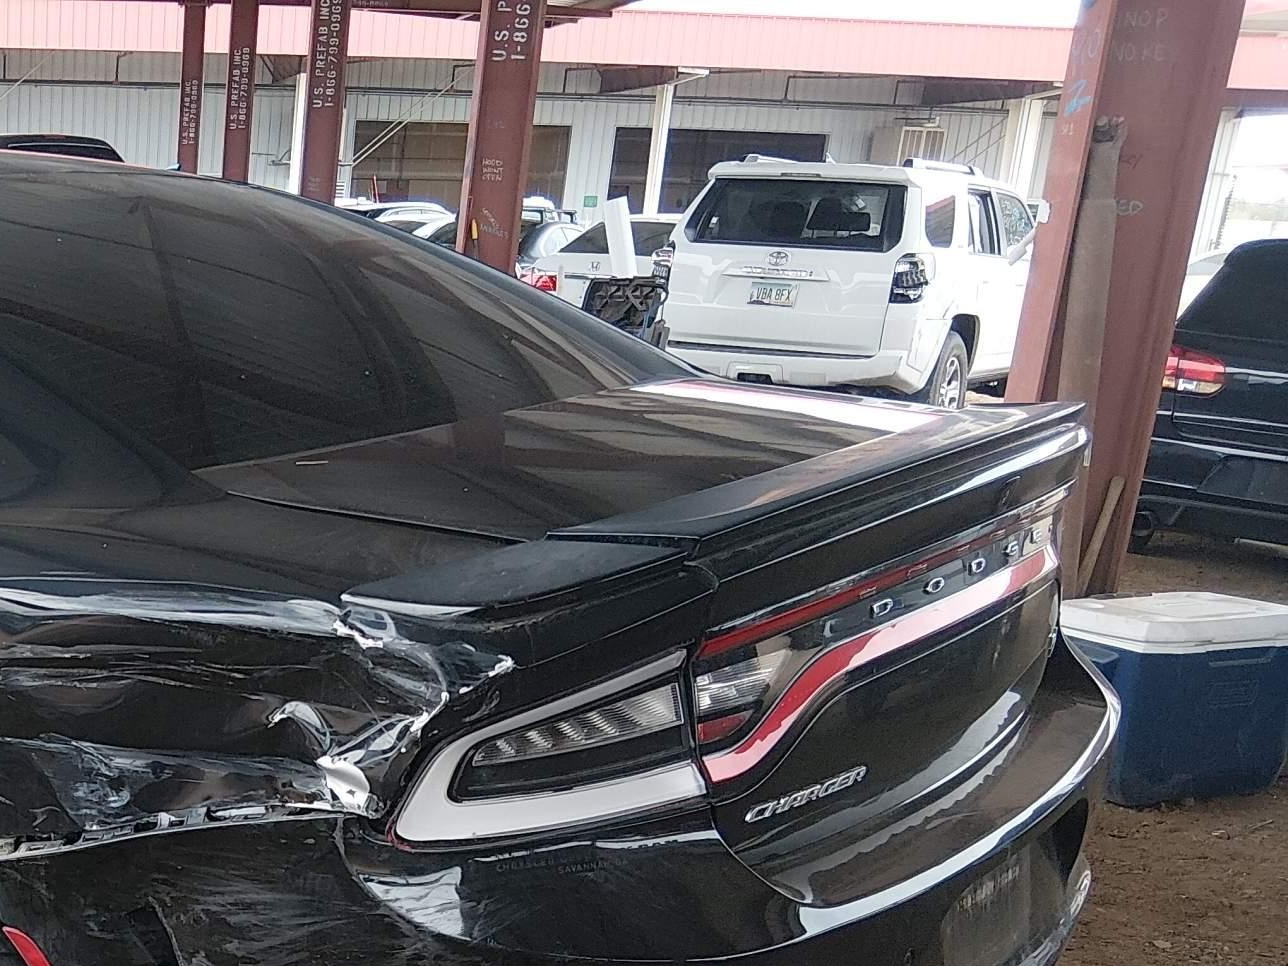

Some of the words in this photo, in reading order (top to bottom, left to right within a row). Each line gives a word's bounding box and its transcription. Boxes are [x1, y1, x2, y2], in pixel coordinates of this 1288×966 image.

[315, 27, 328, 76] PREFAB
[492, 24, 511, 61] U.S.
[230, 69, 240, 107] PREFAB
[312, 84, 324, 108] U.S.
[182, 97, 191, 127] PREFAB
[229, 111, 239, 130] U.S.
[482, 157, 503, 167] HOOD
[870, 527, 1043, 620] DODGE
[745, 764, 868, 823] CHARGER
